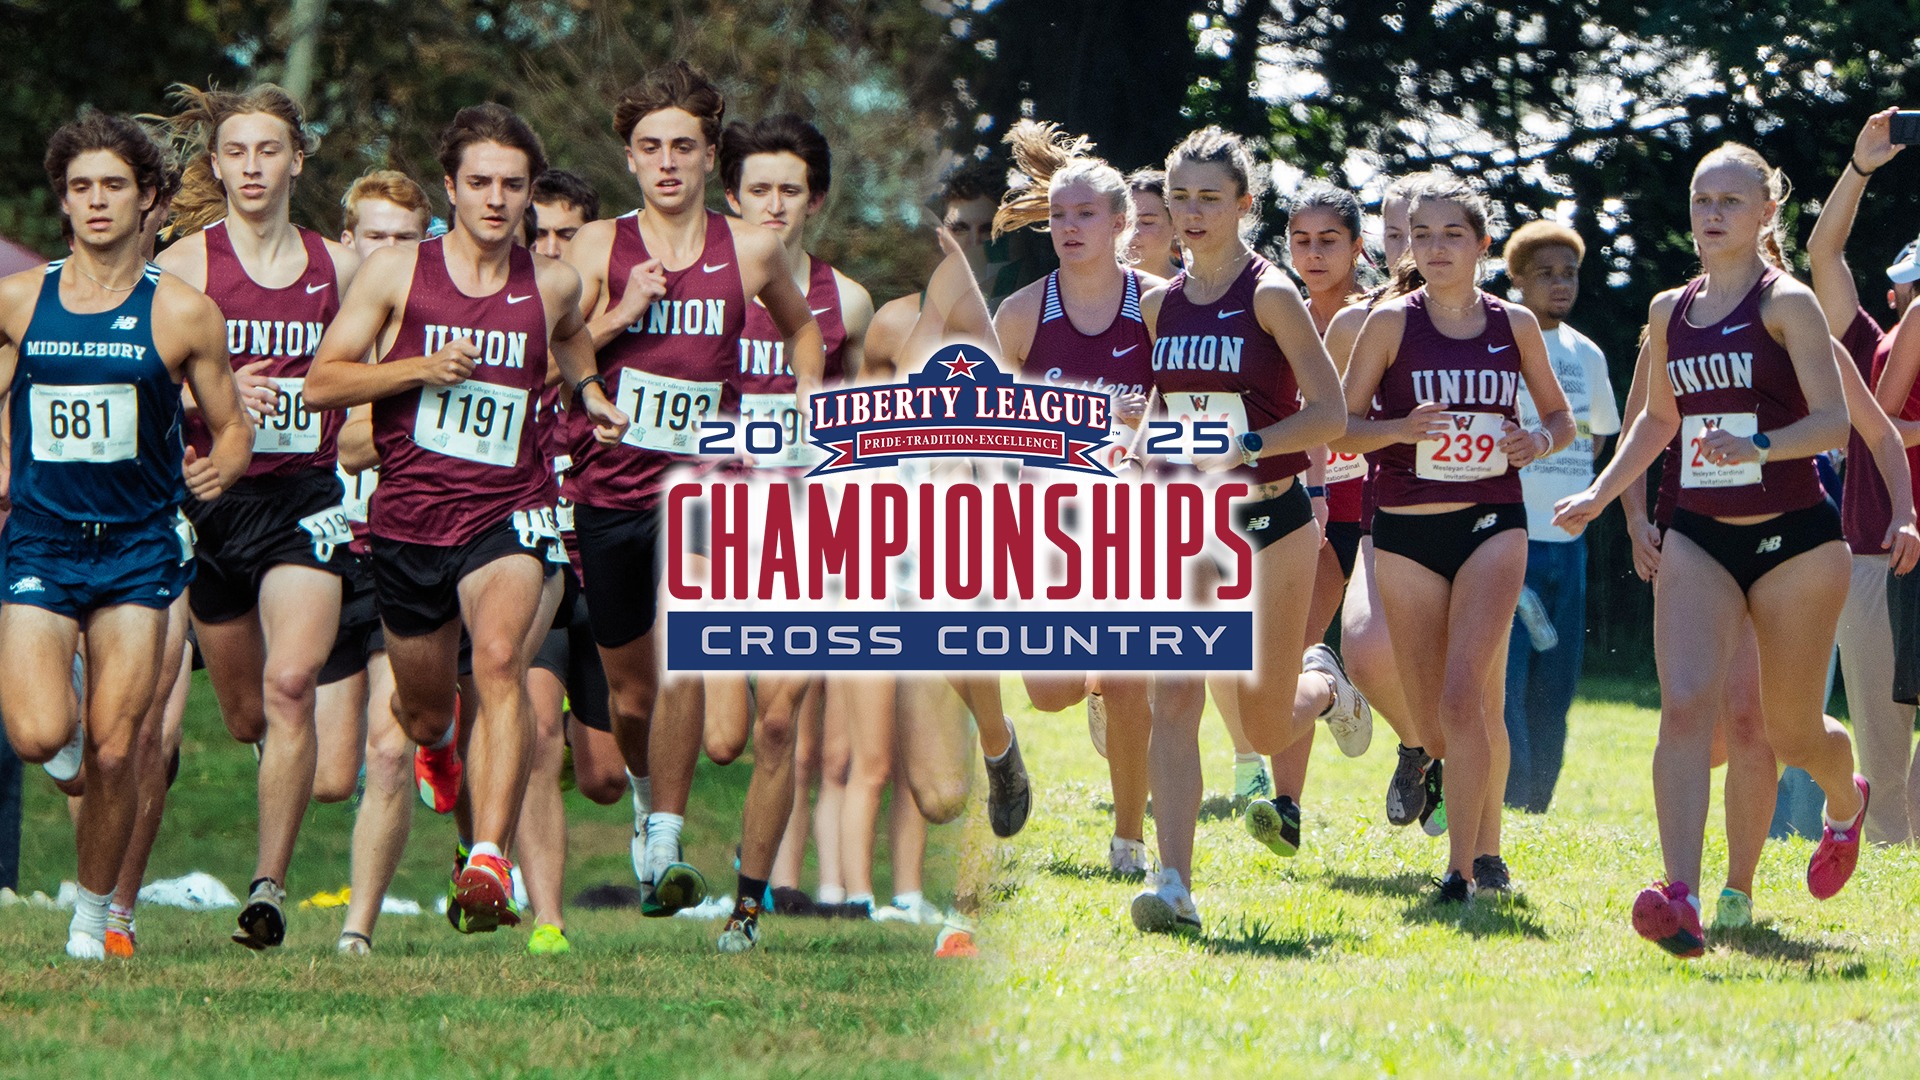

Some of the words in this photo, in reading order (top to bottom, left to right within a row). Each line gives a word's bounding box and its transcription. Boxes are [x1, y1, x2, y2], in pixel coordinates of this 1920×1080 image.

[26, 340, 147, 360] MIDDLEBURY
[226, 319, 324, 356] UNION
[1151, 335, 1244, 373] UNION
[1411, 369, 1517, 407] UNION
[1666, 351, 1753, 397] UNION
[50, 399, 110, 440] 681
[436, 389, 515, 442] 1191
[1431, 433, 1495, 463] 239
